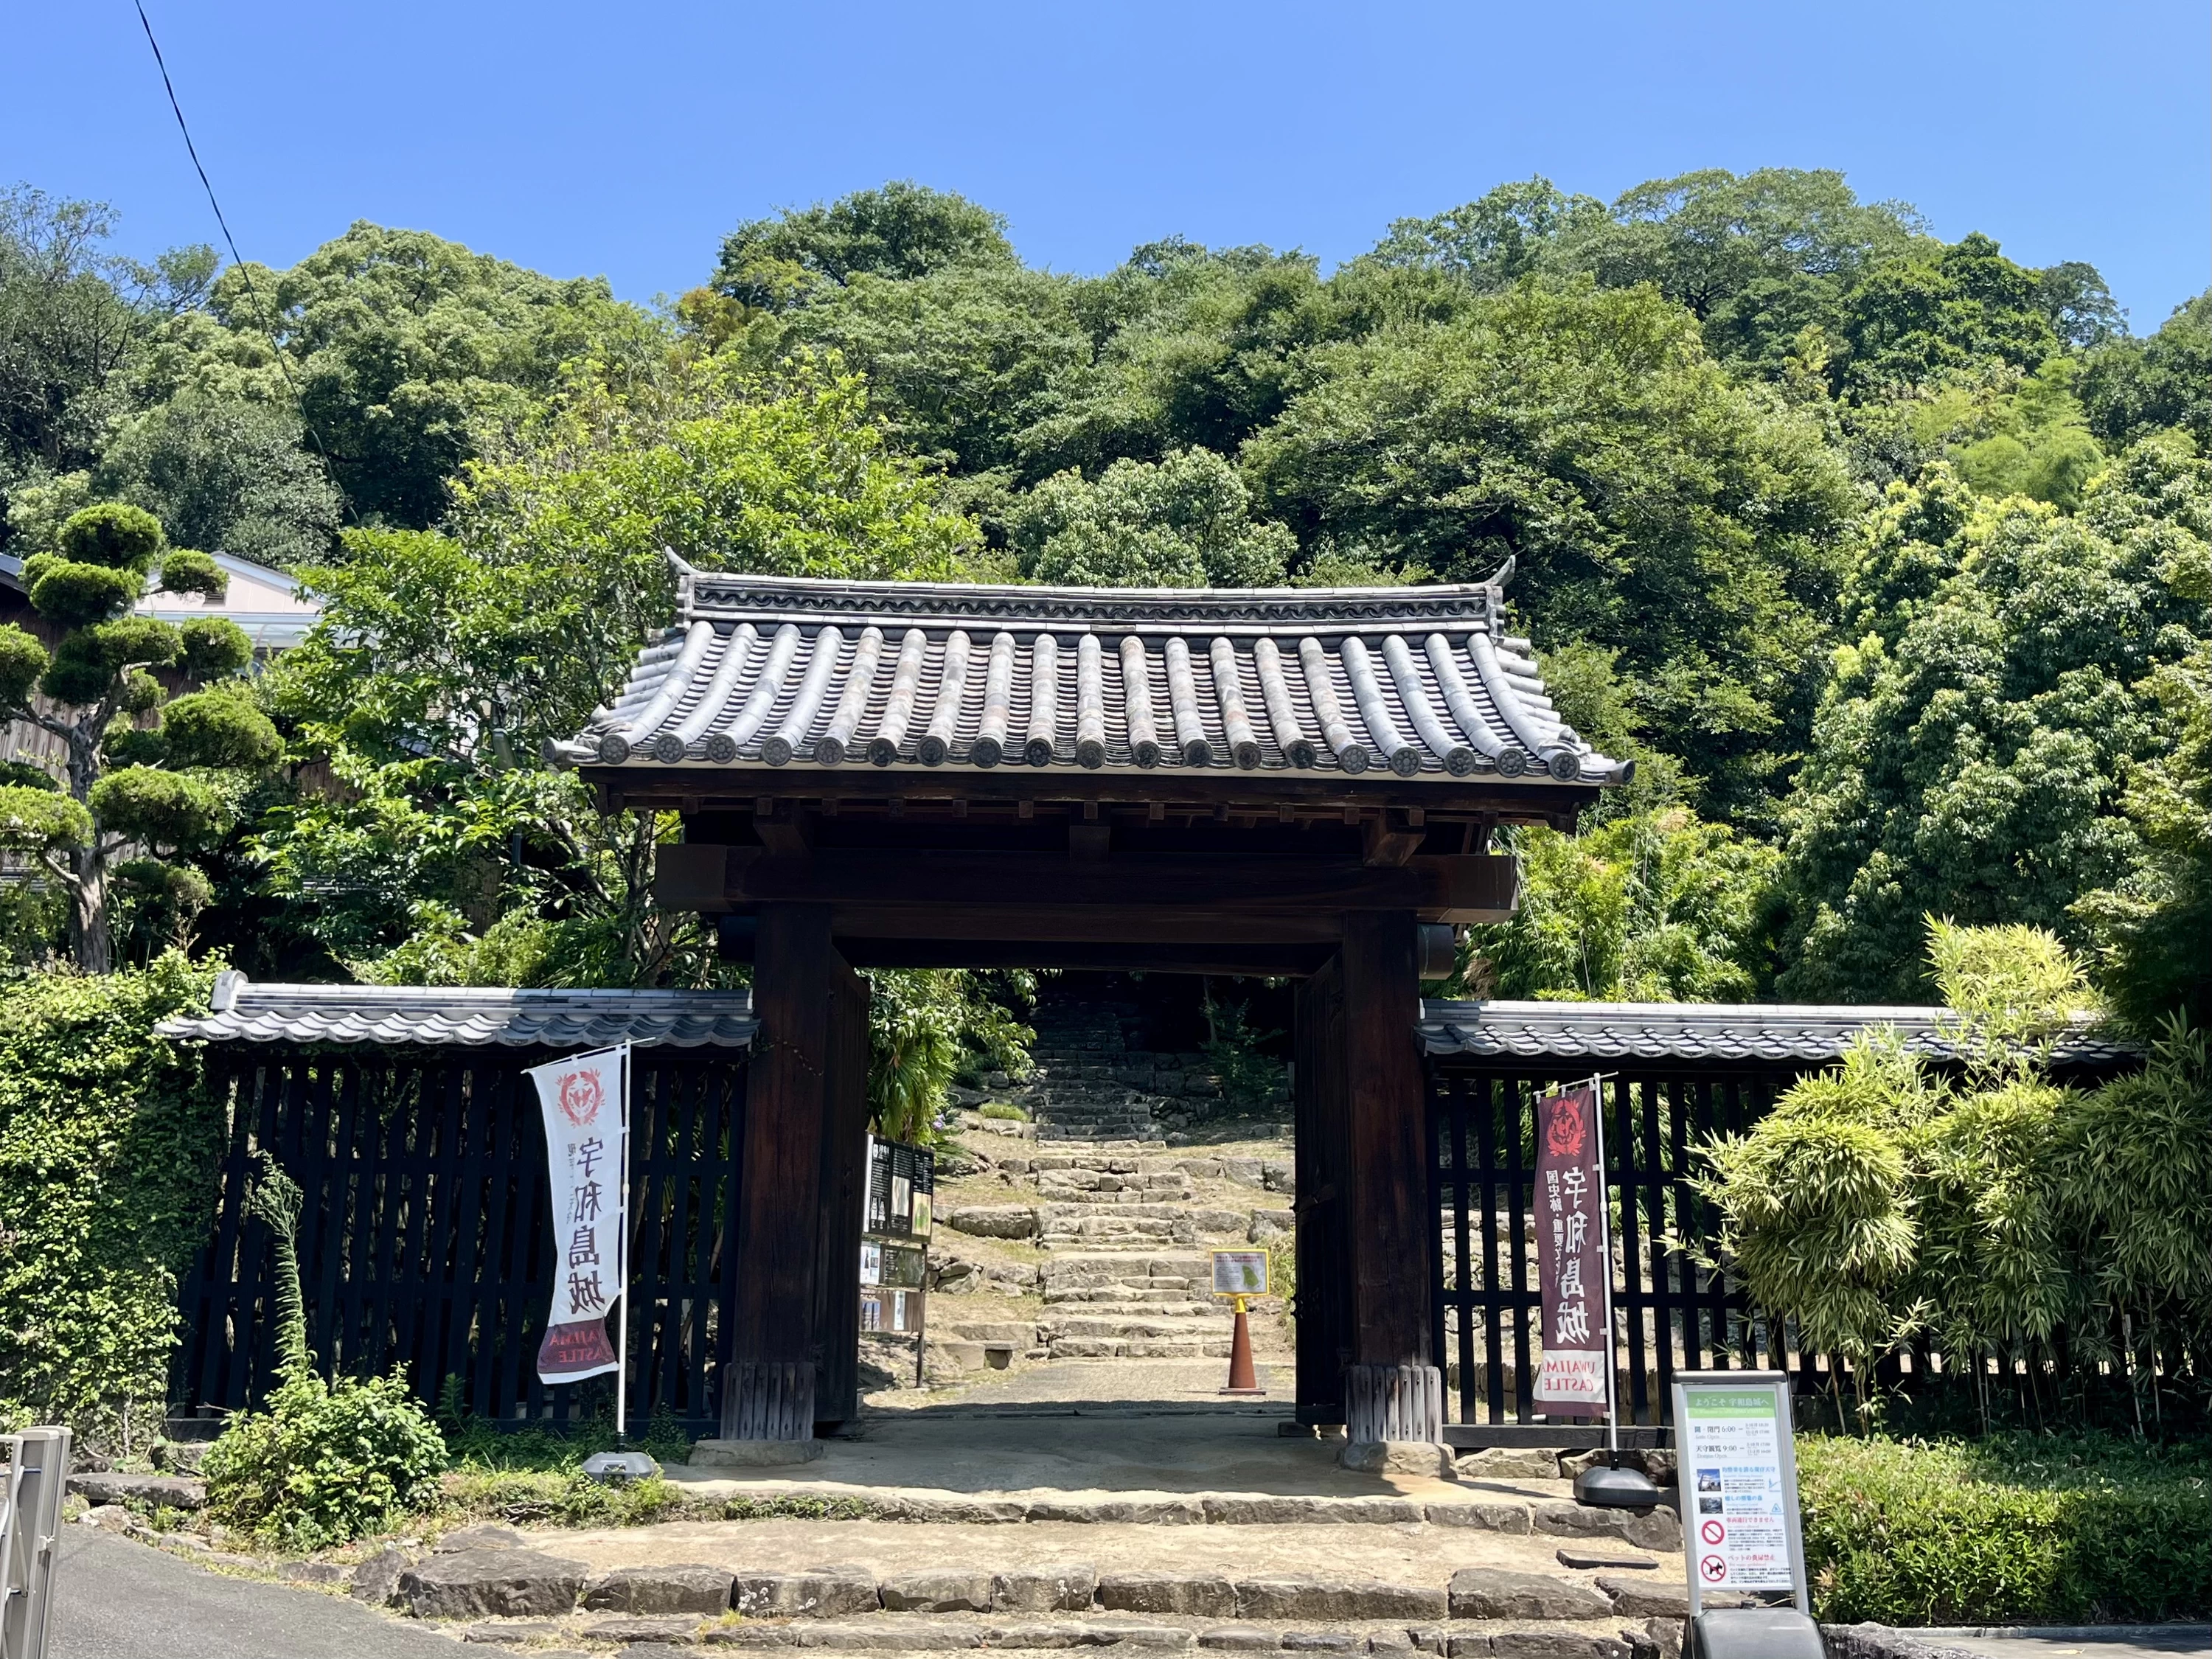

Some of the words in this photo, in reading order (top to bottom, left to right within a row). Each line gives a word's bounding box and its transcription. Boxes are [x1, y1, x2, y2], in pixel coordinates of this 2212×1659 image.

[1696, 1397, 1725, 1407] ようこそ
[1729, 1397, 1769, 1407] 宇和島城へ
